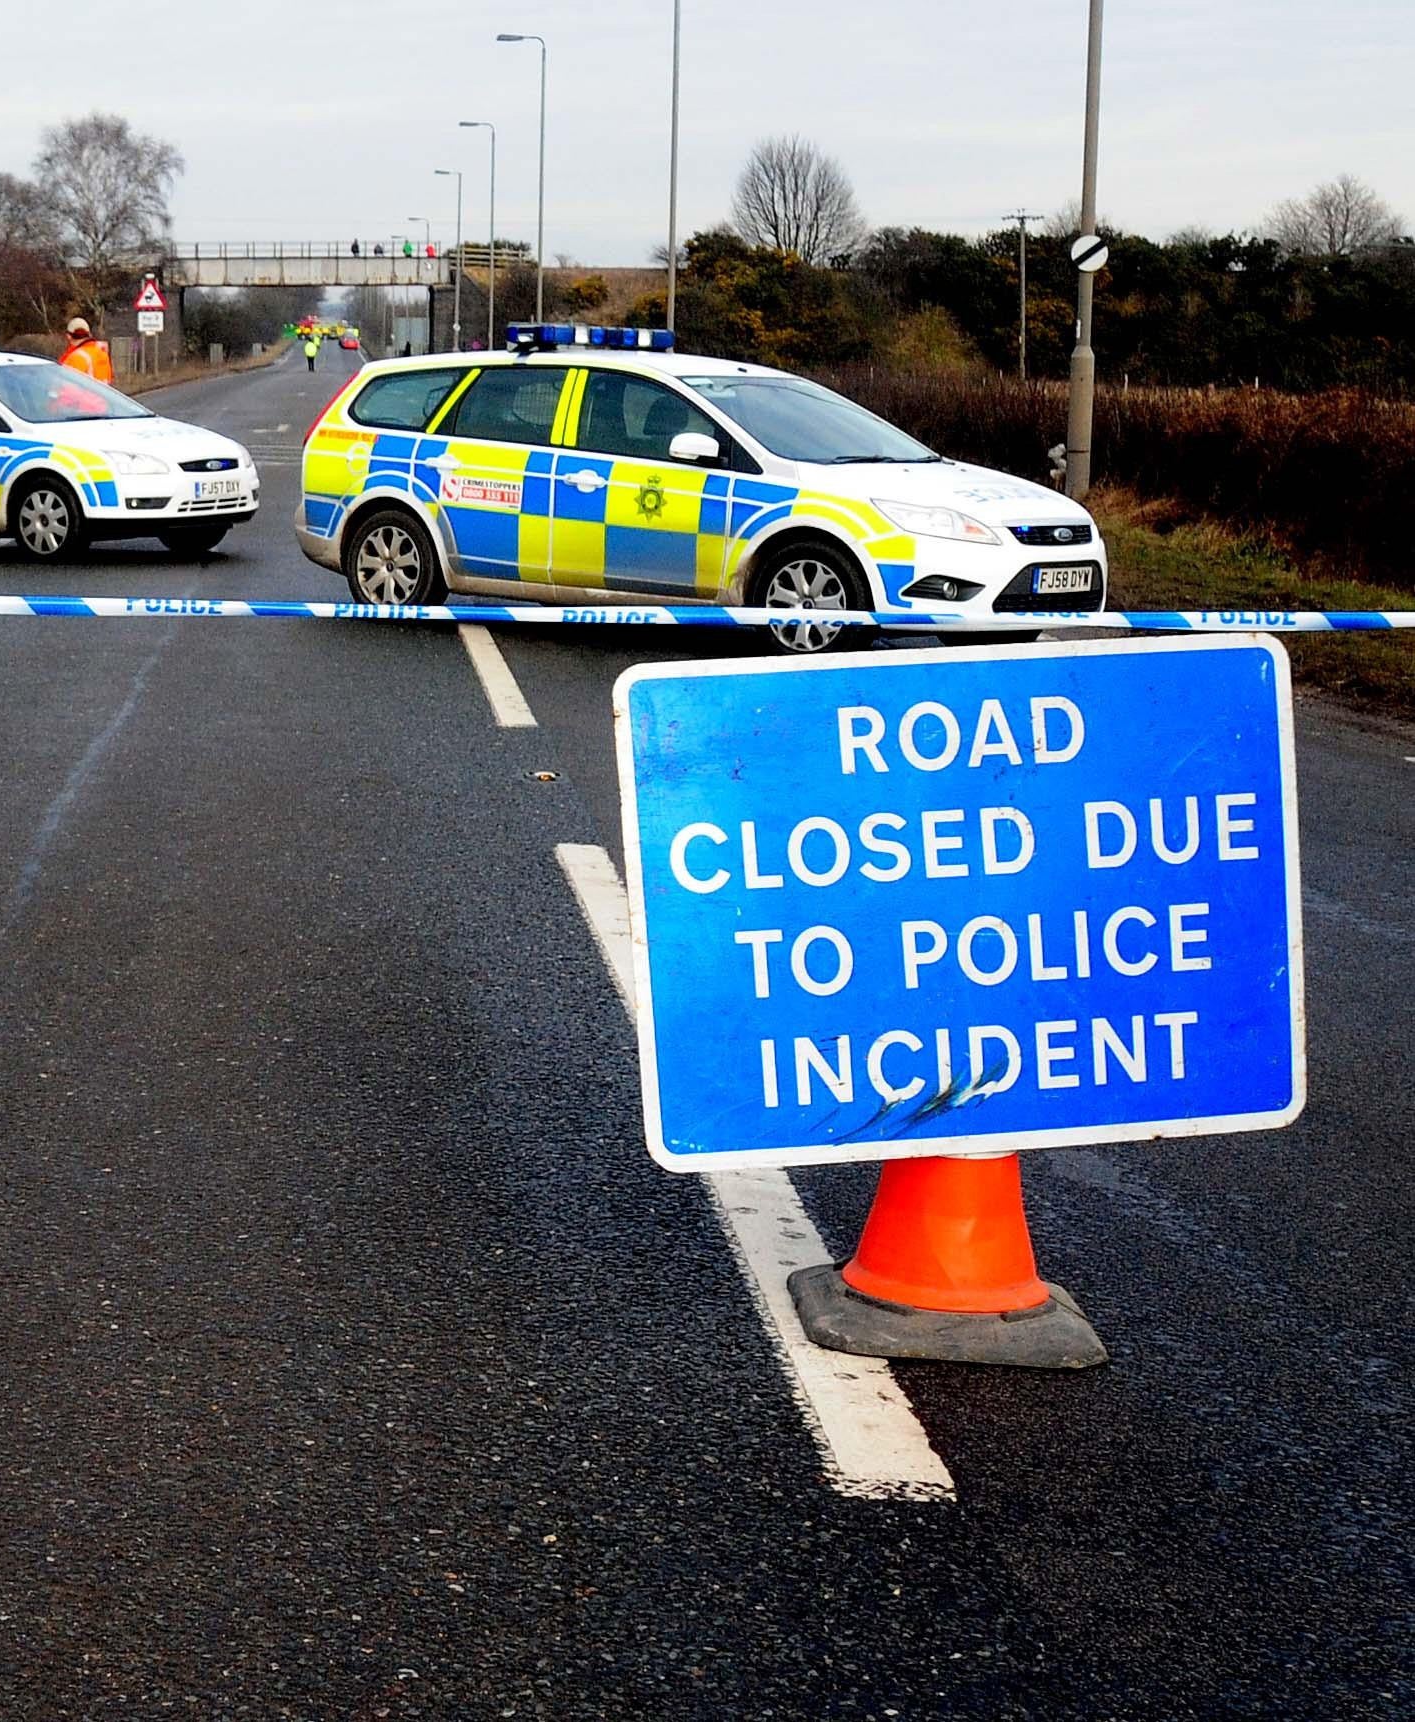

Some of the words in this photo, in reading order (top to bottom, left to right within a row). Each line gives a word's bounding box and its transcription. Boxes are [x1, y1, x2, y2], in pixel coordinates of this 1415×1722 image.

[201, 482, 225, 495] FJ57
[462, 478, 521, 491] CRIMESTOPPERS
[1040, 571, 1069, 590] FJ58
[1070, 569, 1090, 588] DYW
[838, 696, 1085, 775] ROAD
[670, 806, 1035, 894] CLOSED
[1084, 792, 1259, 869] DUE
[734, 925, 854, 998] TO
[901, 902, 1212, 989] POLICE
[760, 1011, 1198, 1108] INCIDENT
